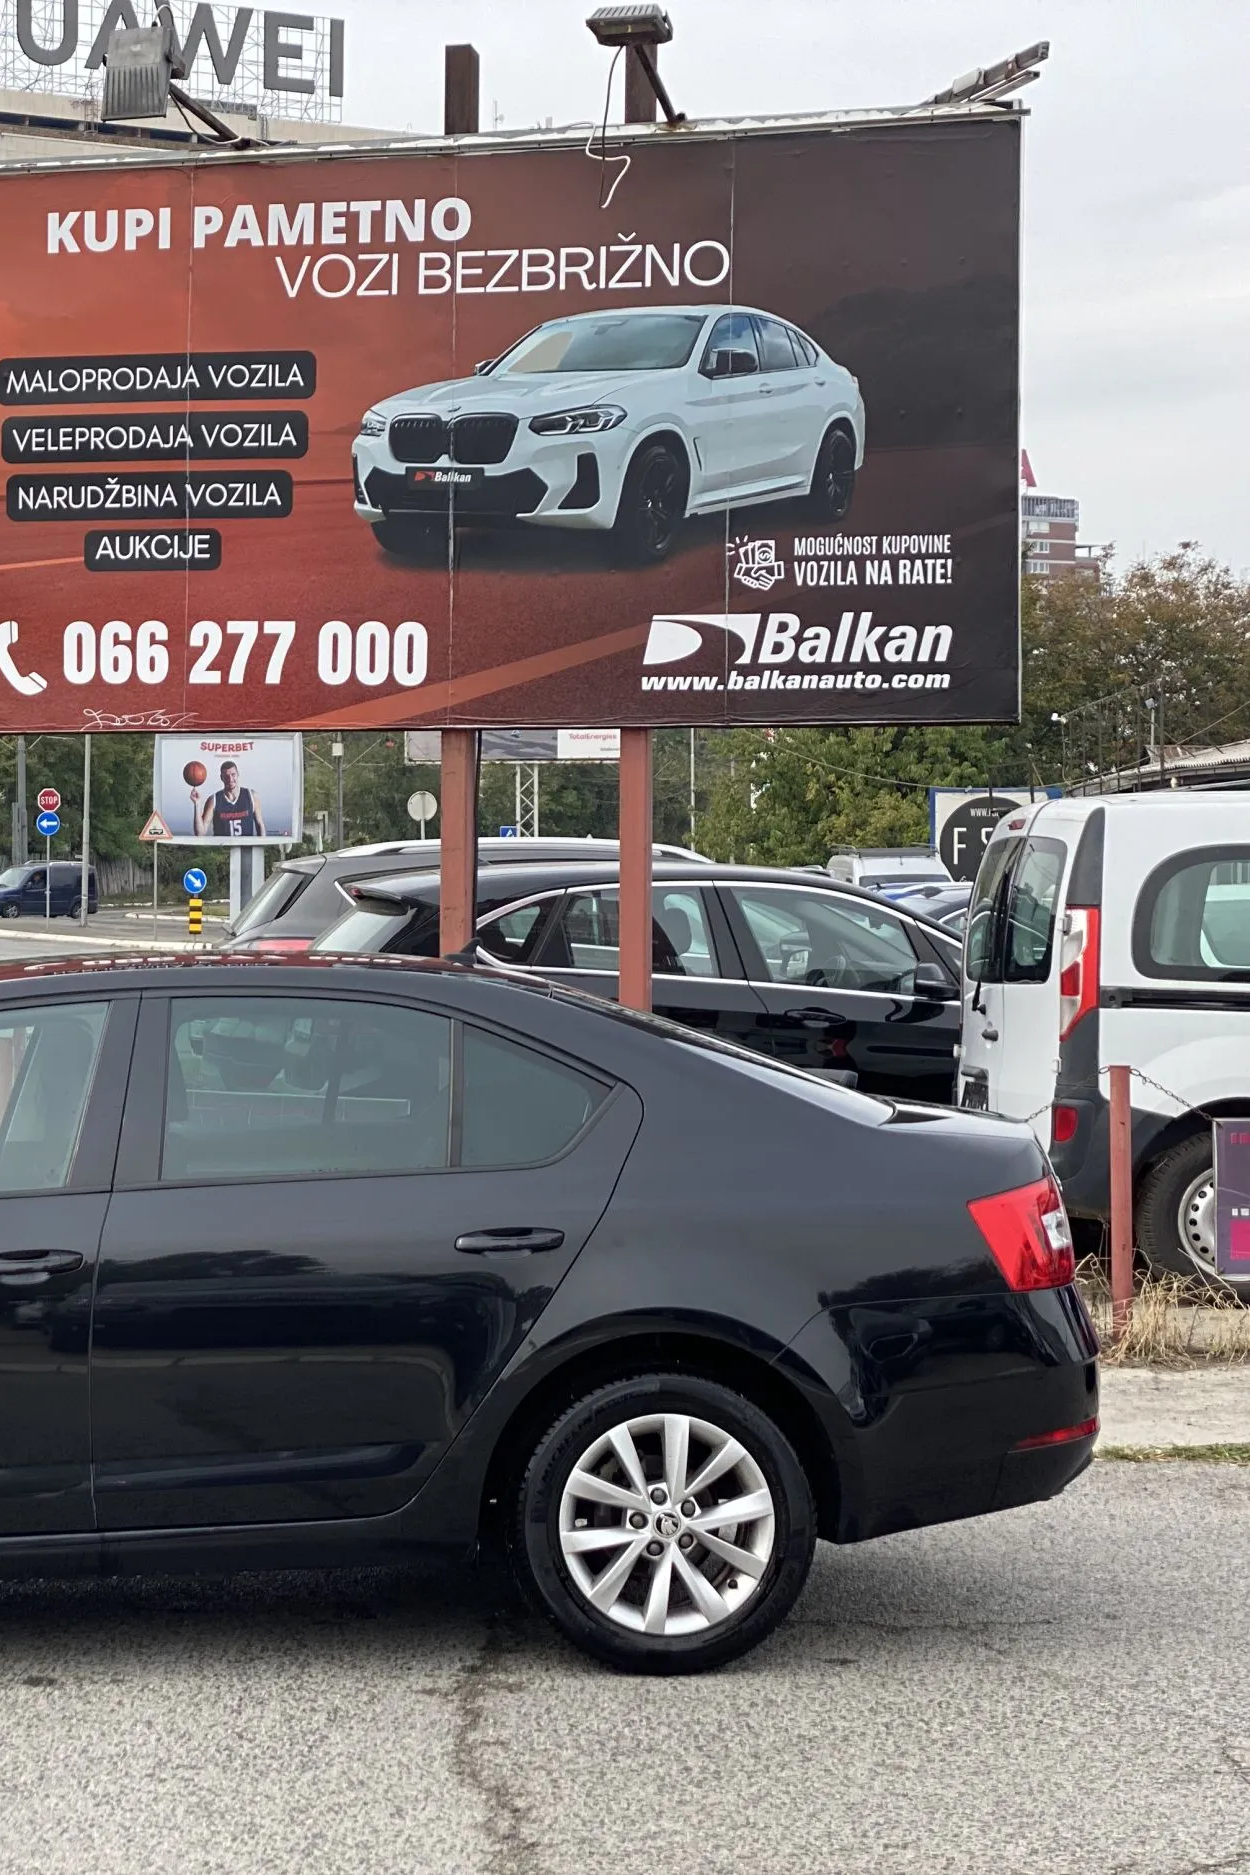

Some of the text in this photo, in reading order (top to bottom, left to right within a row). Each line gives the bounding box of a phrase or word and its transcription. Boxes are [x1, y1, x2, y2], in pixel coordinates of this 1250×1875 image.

[47, 197, 472, 254] KUPI PAMETNO
[275, 231, 731, 298] VOZI BEZBRIŽNO
[6, 363, 305, 394] MALOPRODAJA VOZILA
[12, 422, 298, 452] VELEPRODAJA VOZILA
[434, 471, 472, 482] Balkan
[18, 477, 282, 510] NARUDŽBINA VOZILA
[95, 534, 211, 560] AUKCIJE
[794, 533, 951, 556] MOGUĆNOST KUPOVINE
[794, 558, 953, 586] VOZILA NA RATE!
[757, 611, 953, 664] Balkan
[63, 620, 429, 687] 066 277 000
[641, 670, 951, 691] www.balkanauto.com
[200, 741, 254, 752] SUPERBET
[568, 733, 617, 741] TotalEnergies
[40, 796, 58, 805] STOP
[229, 819, 242, 836] 15
